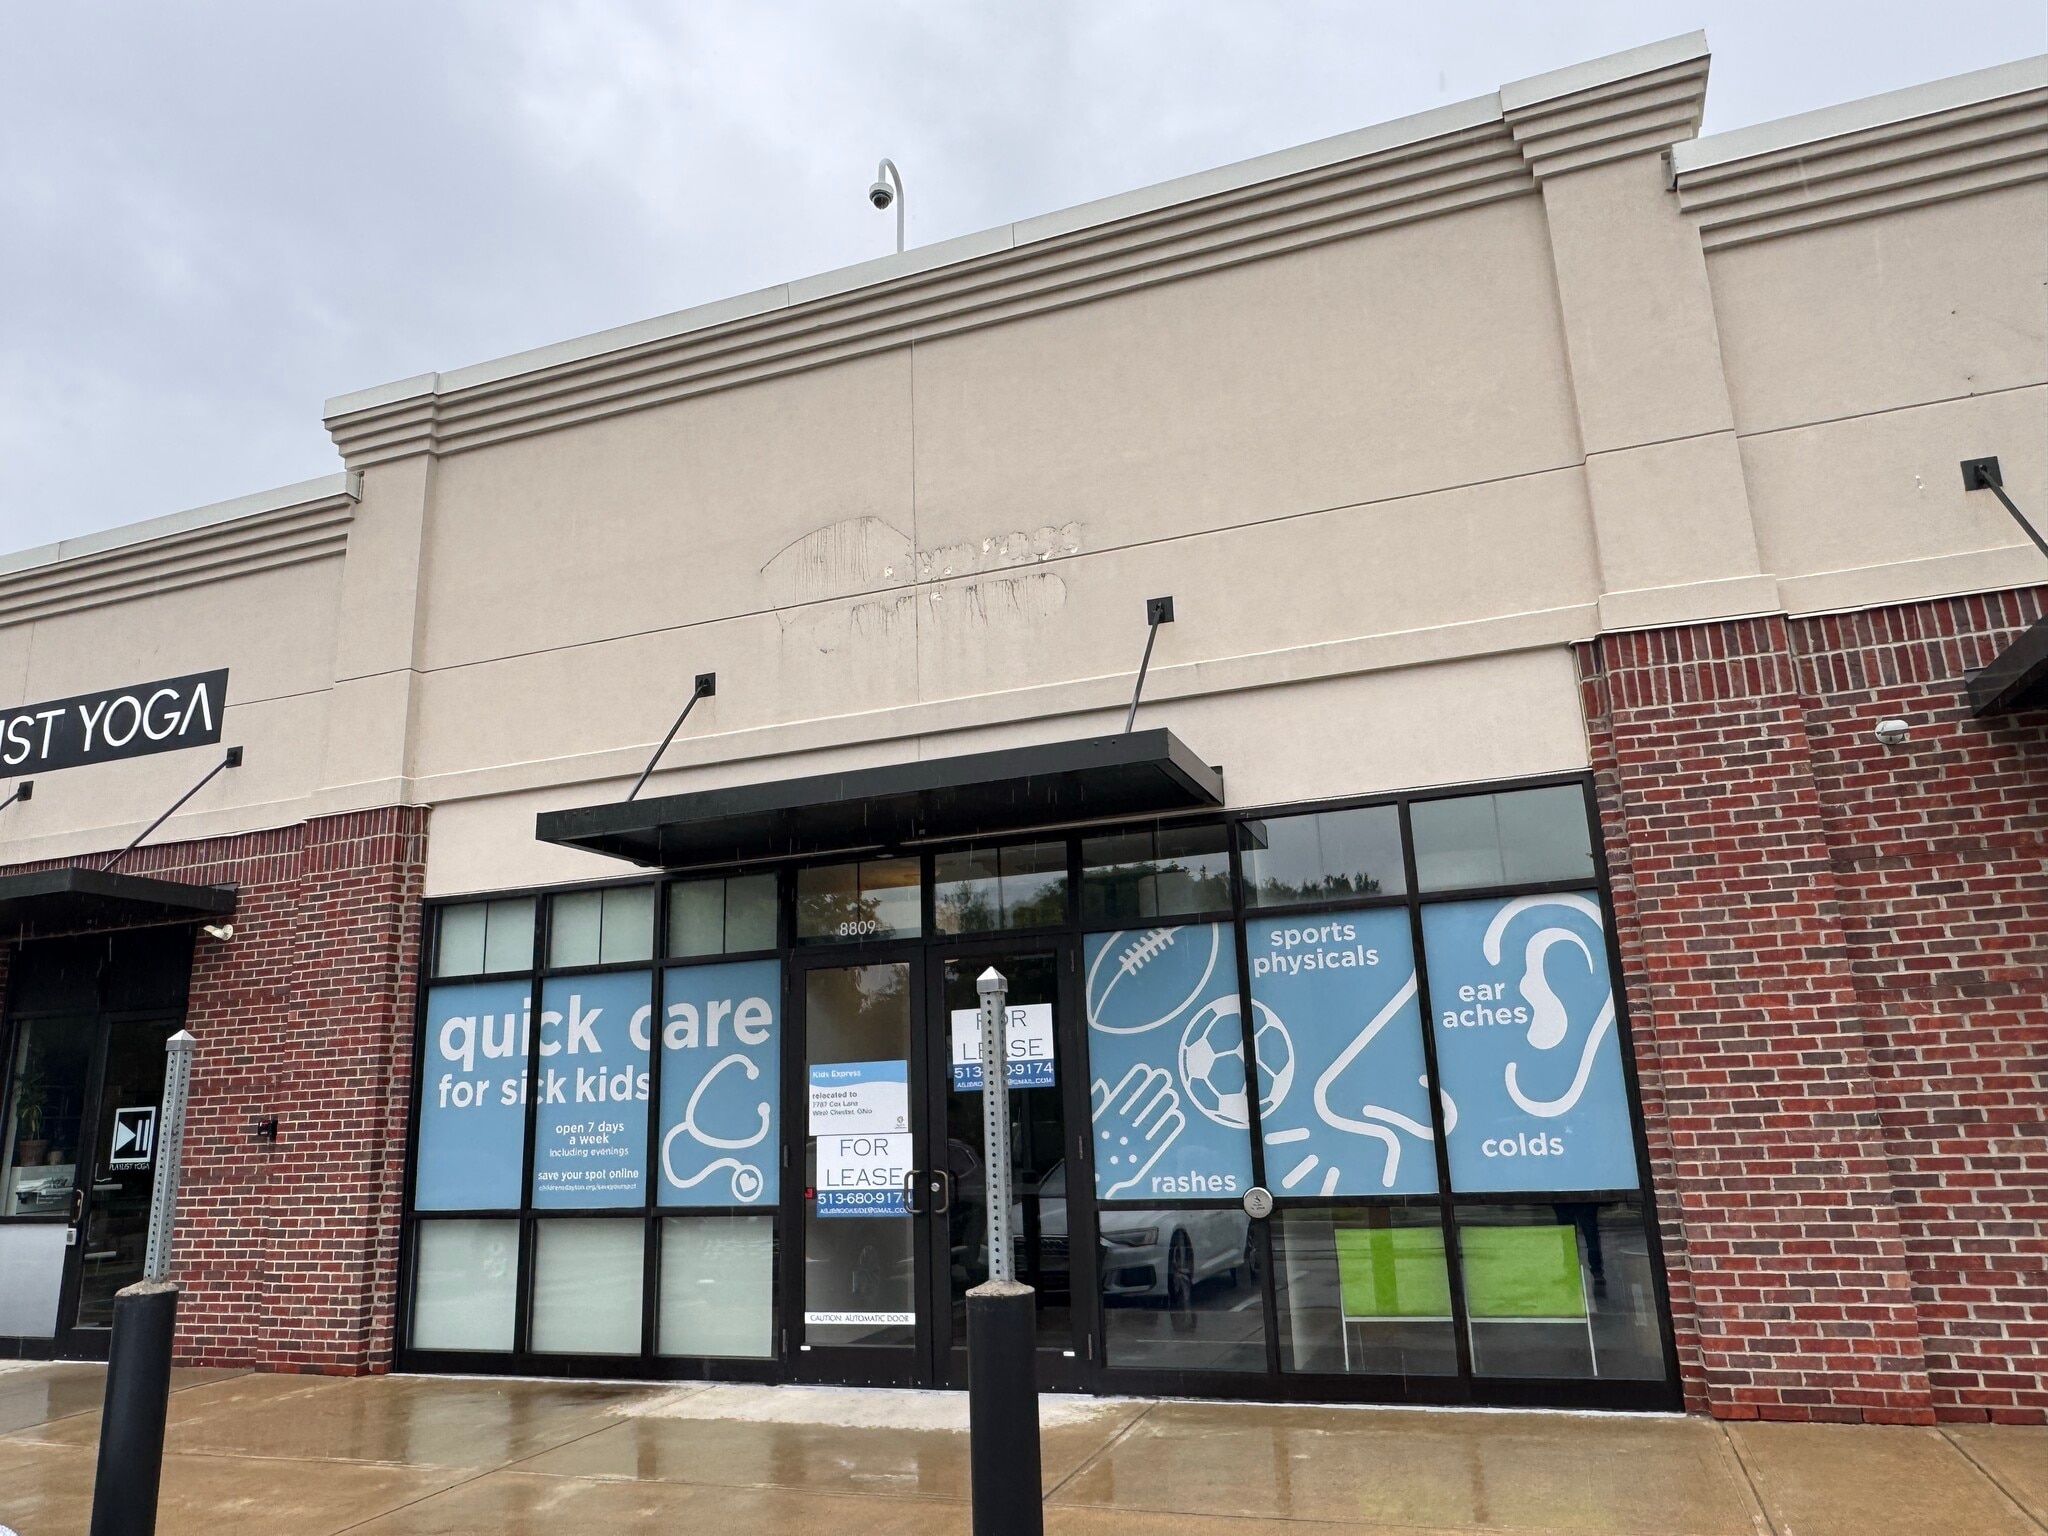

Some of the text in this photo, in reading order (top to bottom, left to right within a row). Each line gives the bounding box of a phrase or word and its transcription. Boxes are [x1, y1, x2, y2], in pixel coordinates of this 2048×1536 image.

[840, 920, 876, 936] 8809
[1270, 922, 1356, 950] sports
[1253, 945, 1379, 978] physicals
[1458, 982, 1506, 1002] ear
[976, 1009, 1026, 1030] FR
[1442, 1004, 1528, 1028] aches
[439, 994, 772, 1072] quick care
[831, 1070, 862, 1078] Express
[439, 1073, 490, 1108] for
[576, 1065, 651, 1102] kids
[555, 1121, 624, 1135] open 7 days
[569, 1132, 609, 1145] a week
[840, 1138, 889, 1157] FOR
[1481, 1132, 1564, 1157] colds
[591, 1147, 629, 1156] evenings
[538, 1168, 639, 1181] save your spot online
[826, 1167, 903, 1187] LEASE
[1151, 1170, 1237, 1193] rashes
[887, 1315, 909, 1323] DOOR
